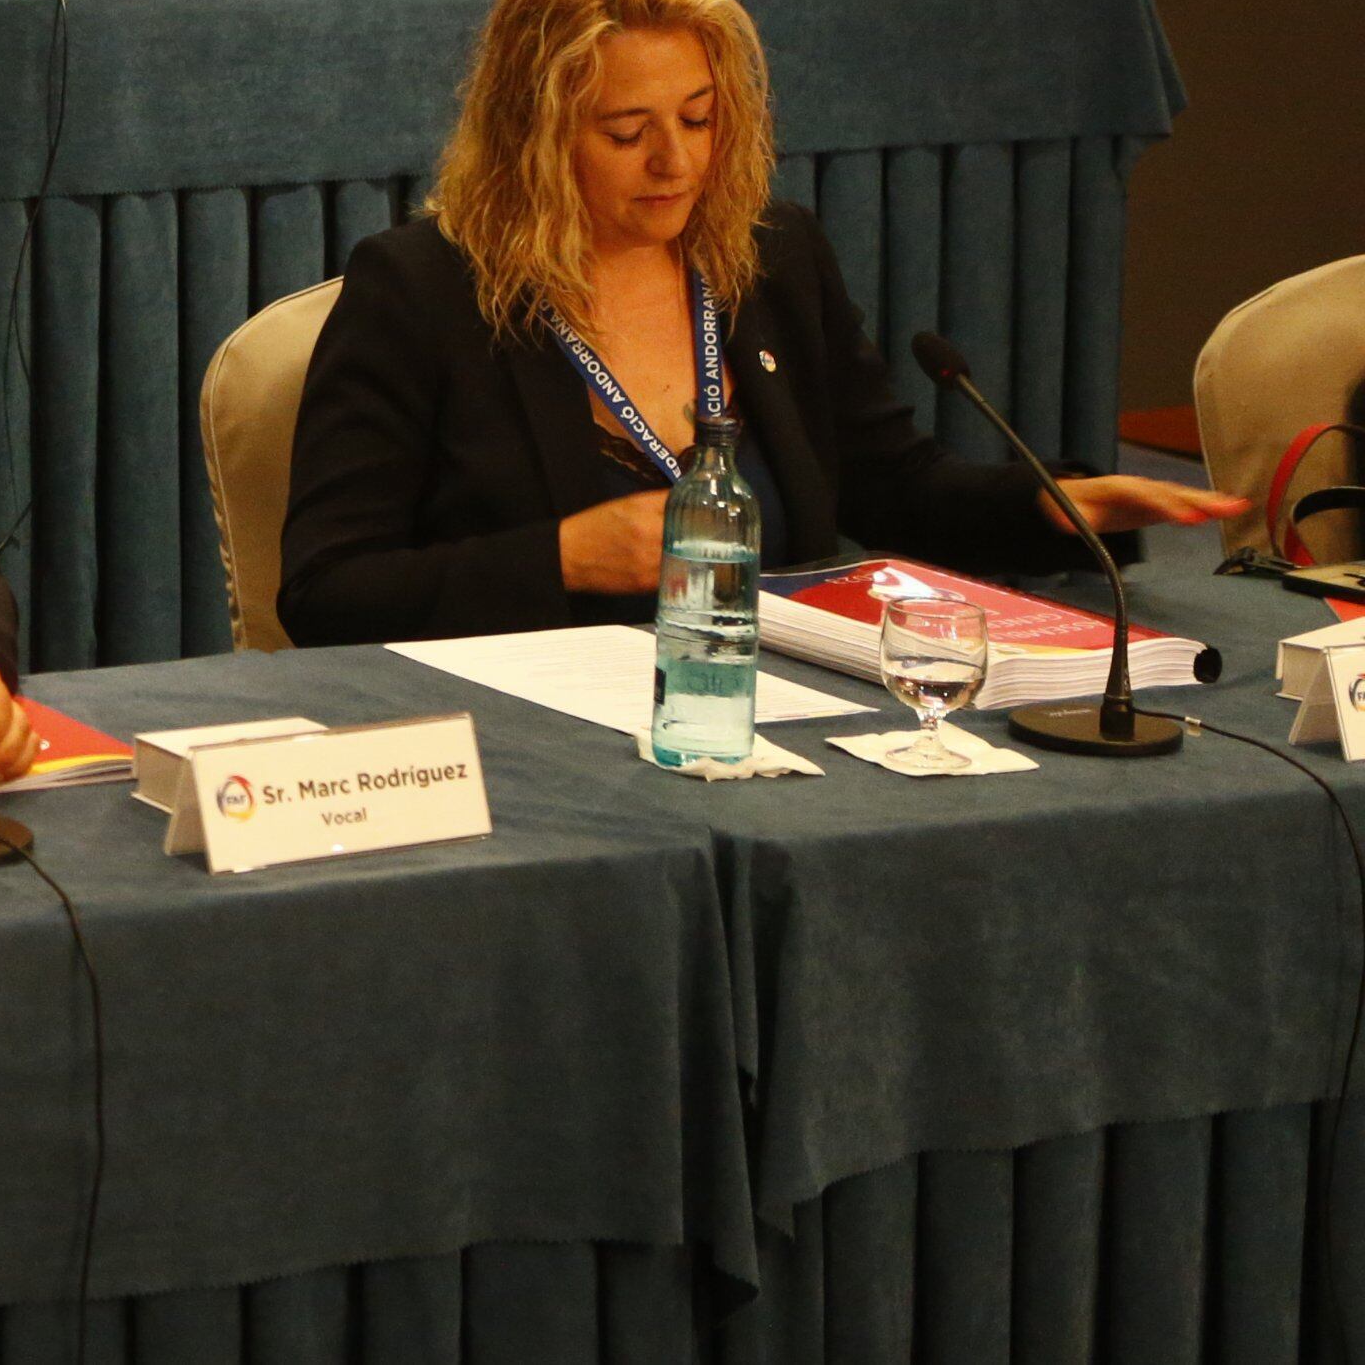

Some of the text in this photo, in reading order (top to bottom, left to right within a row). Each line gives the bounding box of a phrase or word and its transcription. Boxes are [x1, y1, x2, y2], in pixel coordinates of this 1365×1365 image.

[550, 314, 626, 404] ANDORRANA
[620, 405, 682, 479] EDERACIÓ
[263, 785, 292, 805] Sr.
[298, 778, 351, 799] Marc
[321, 807, 368, 826] Vocal
